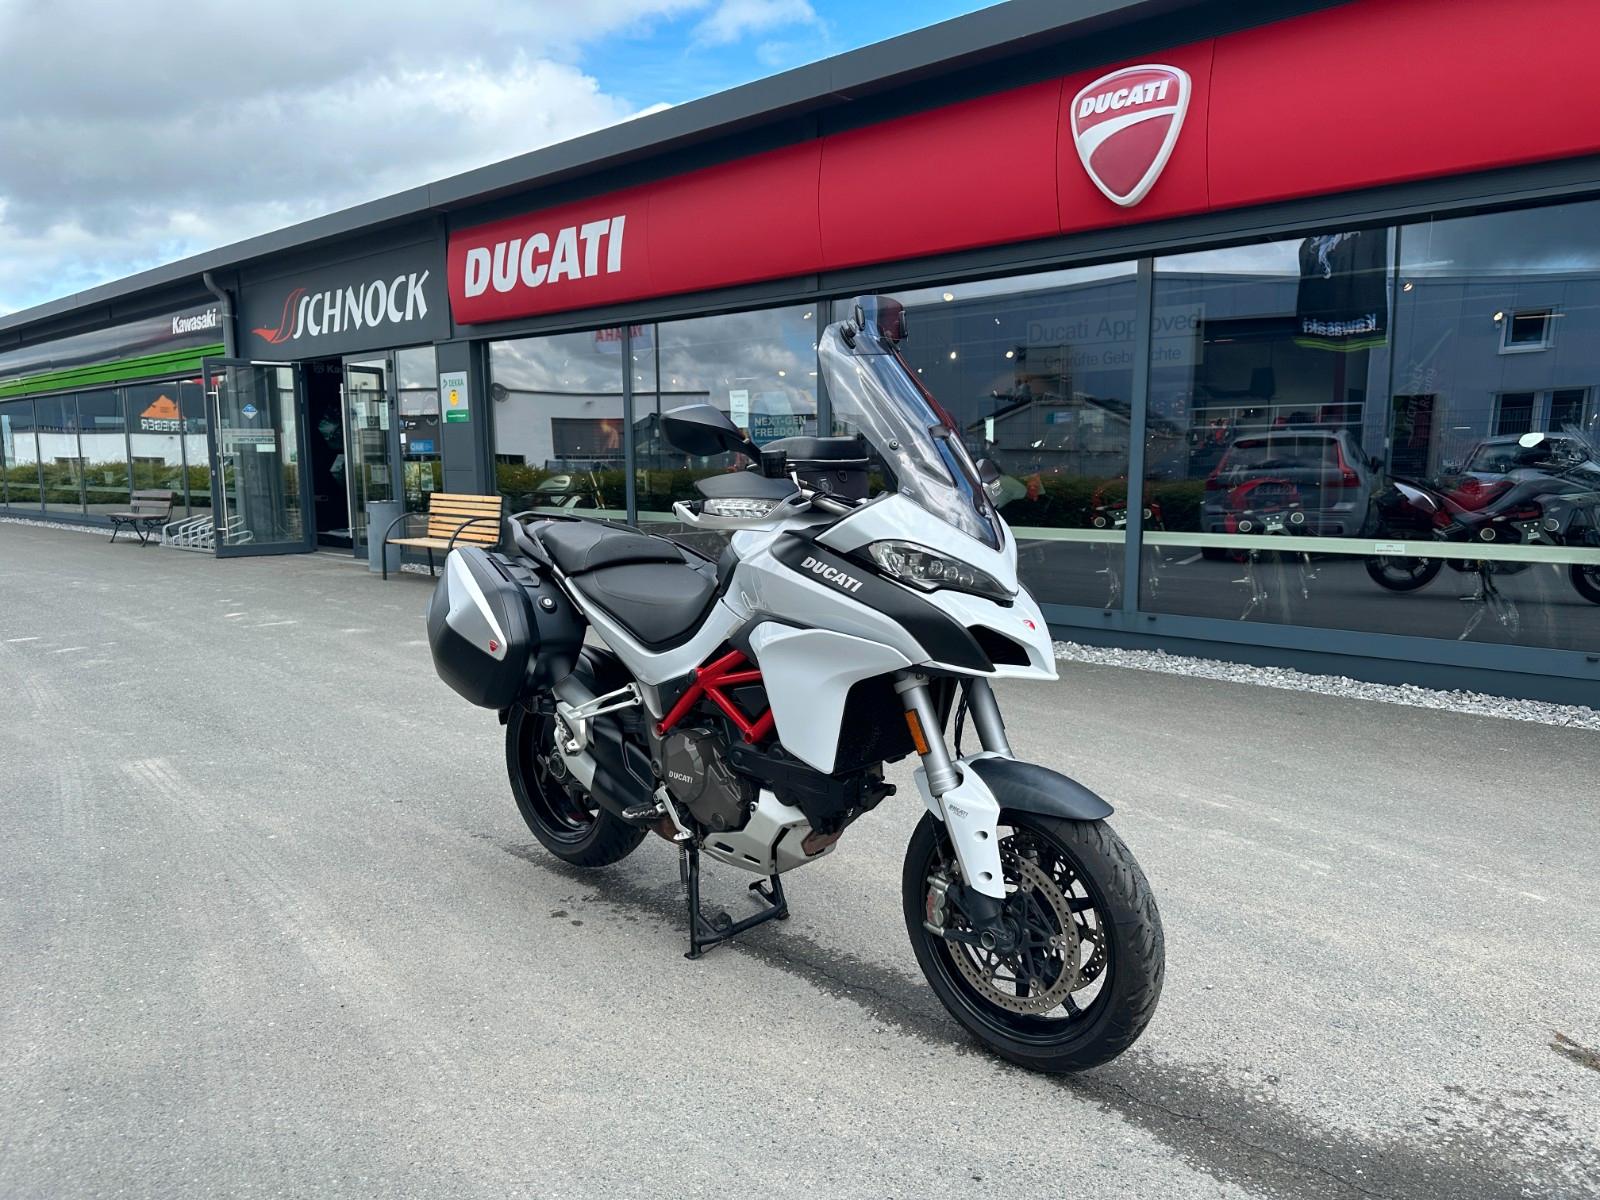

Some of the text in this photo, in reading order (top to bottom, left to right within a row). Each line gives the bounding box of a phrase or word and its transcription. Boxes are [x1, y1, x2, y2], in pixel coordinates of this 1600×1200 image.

[1079, 79, 1169, 119] DUCATI
[464, 214, 626, 299] DUCATI
[172, 308, 217, 335] Kawasaki
[292, 269, 430, 340] SCHNOCK
[1029, 307, 1201, 344] Ducati Appoved
[754, 414, 807, 427] NEXT-GEN
[754, 426, 804, 437] FREEDOM
[800, 556, 864, 593] DUCATI
[668, 770, 694, 784] DUCATI
